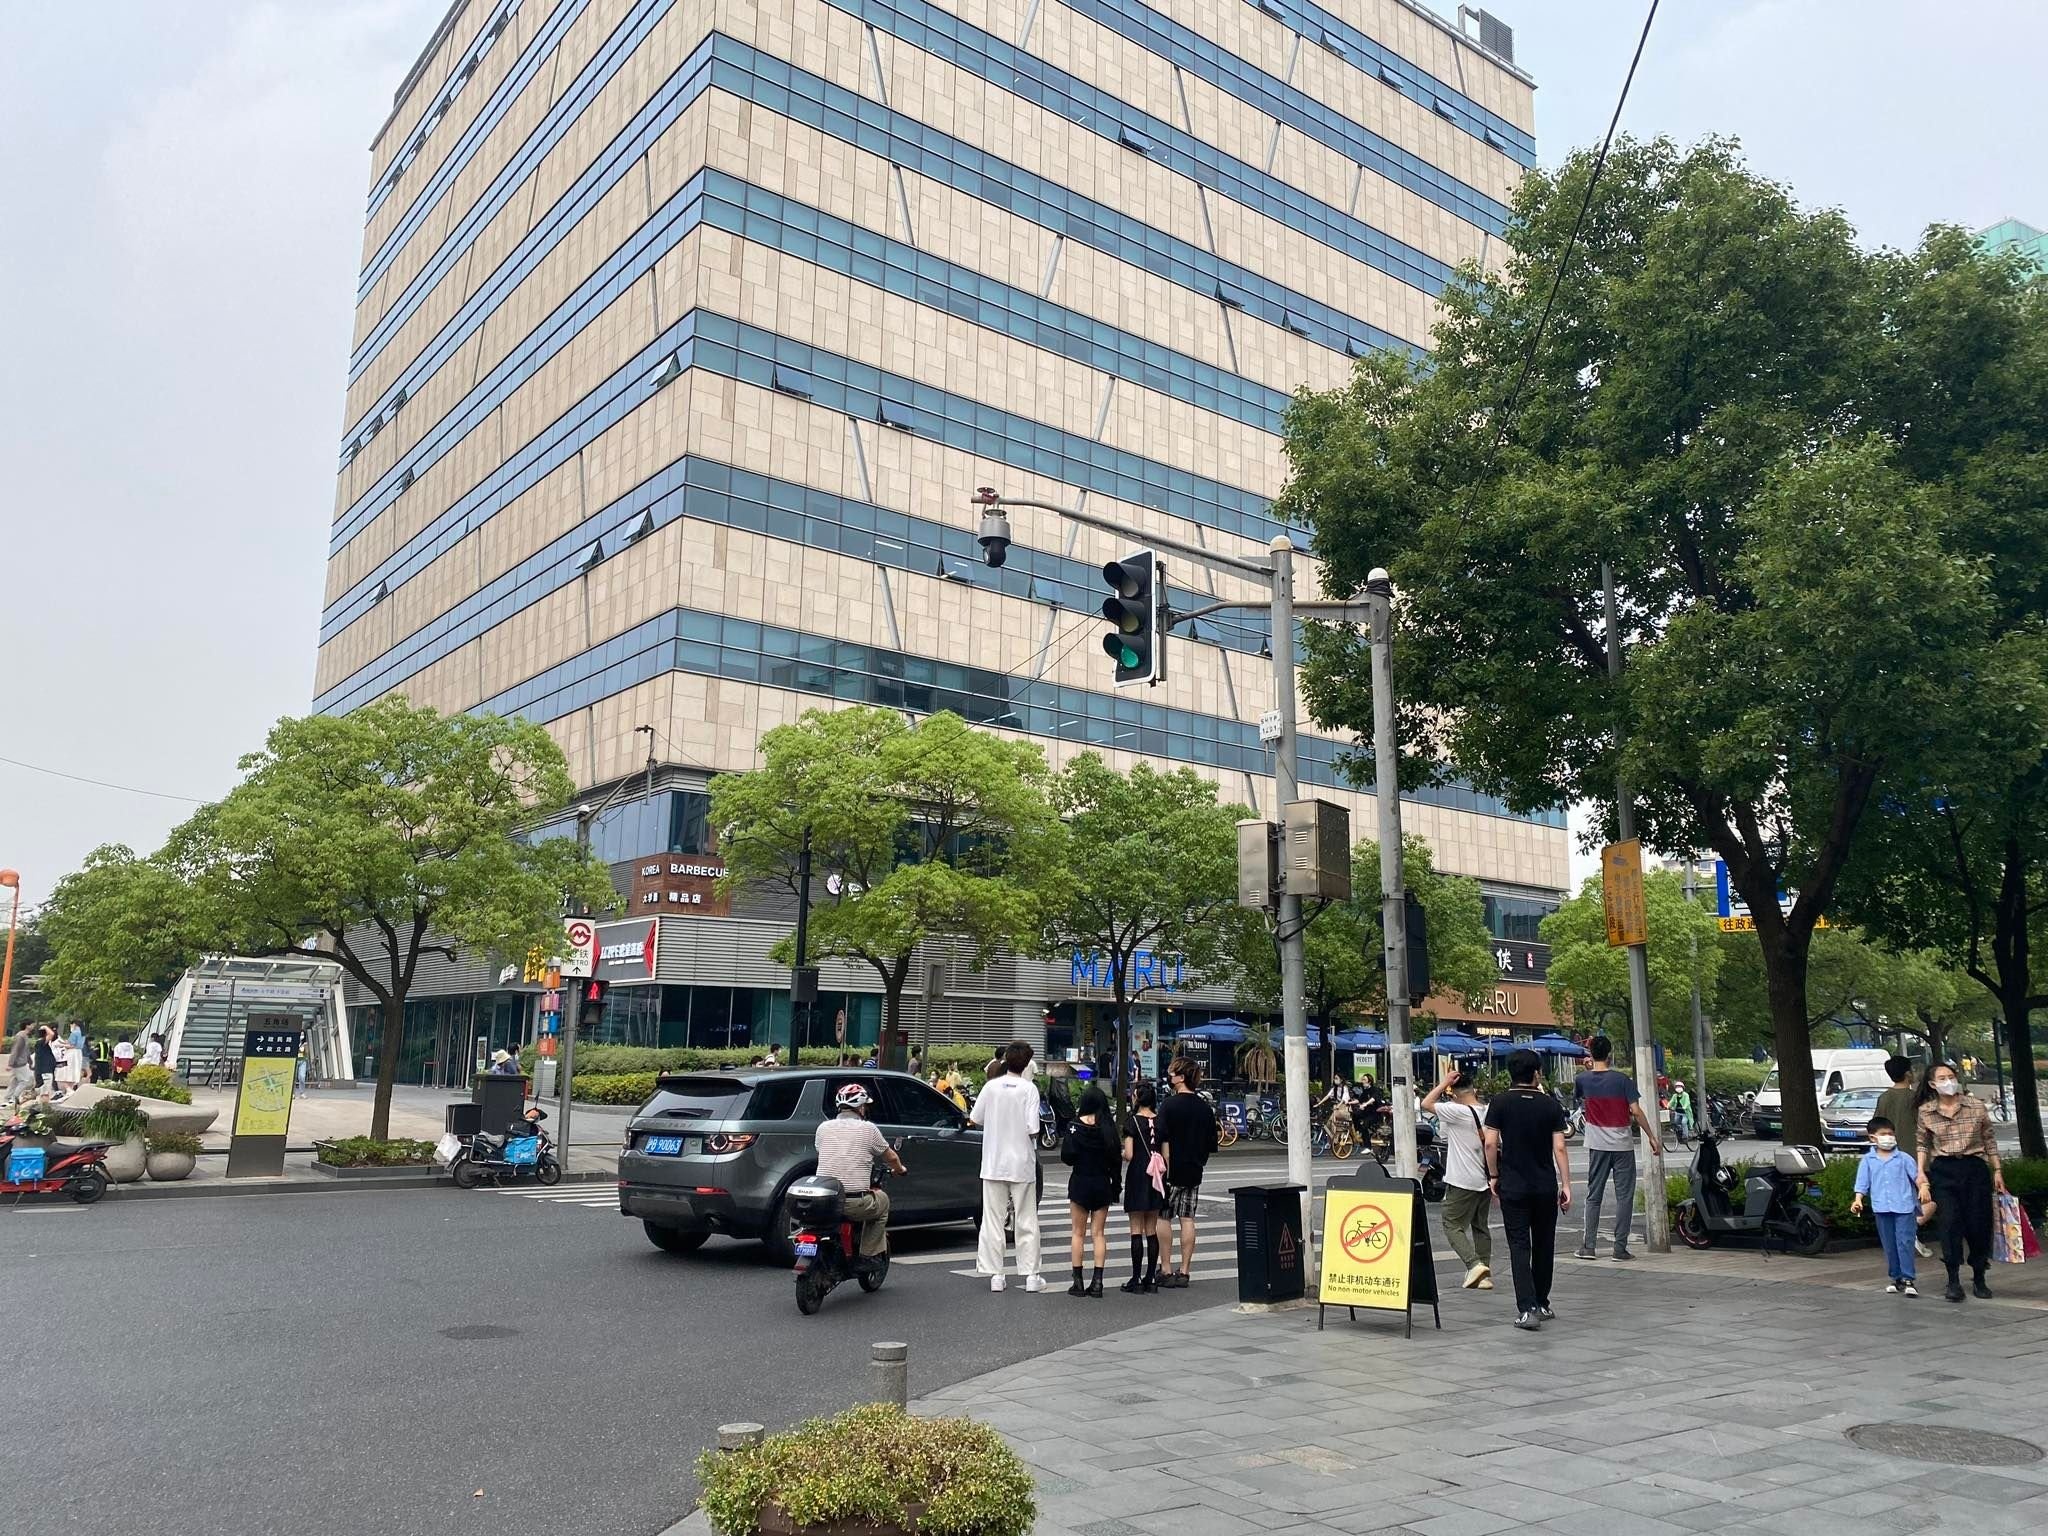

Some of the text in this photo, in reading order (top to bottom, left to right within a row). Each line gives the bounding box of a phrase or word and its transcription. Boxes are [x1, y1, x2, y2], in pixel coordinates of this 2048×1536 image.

[641, 863, 730, 877] KOREA BARBECUE
[668, 892, 701, 904] 精品店
[1071, 945, 1184, 992] MARU
[1328, 1272, 1401, 1289] 禁止非机动车通行
[1372, 1288, 1400, 1297] vehicles
